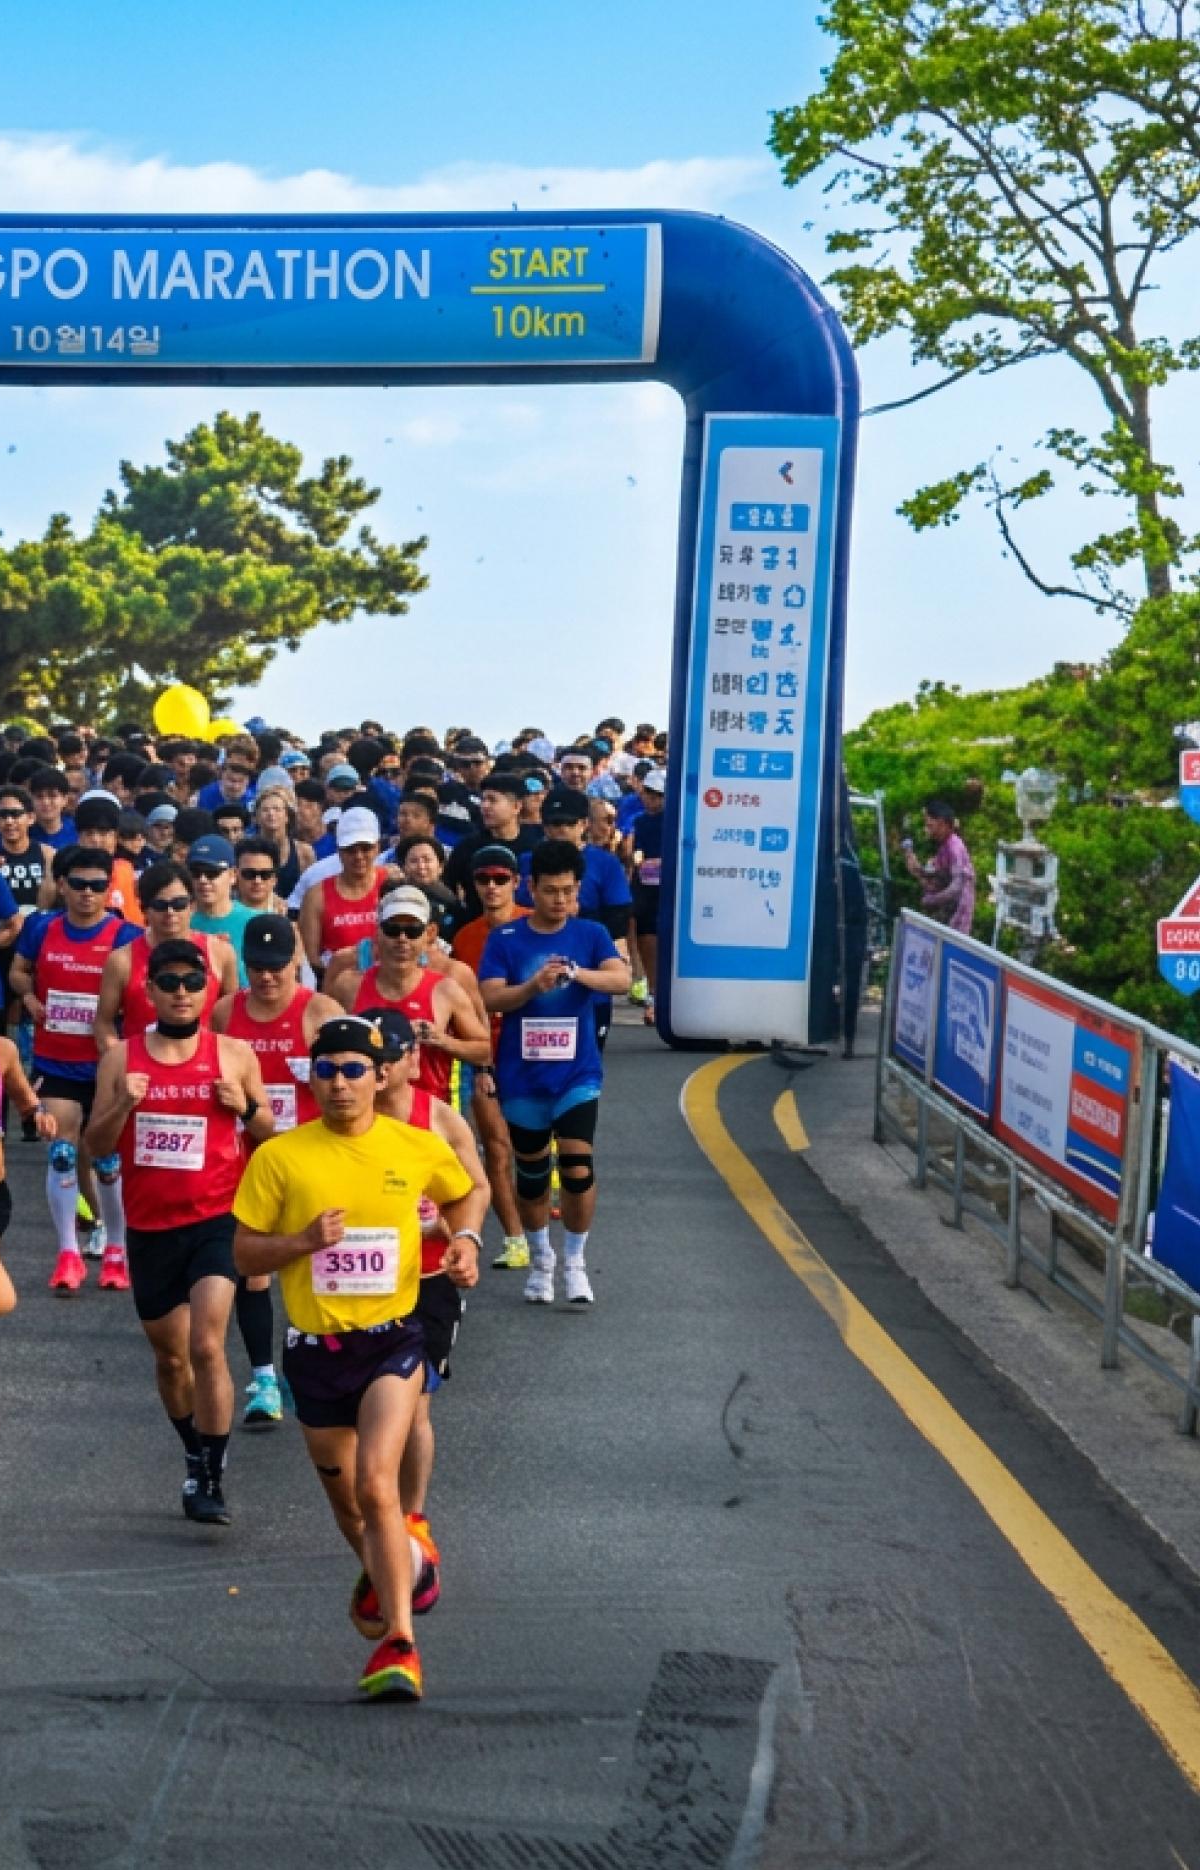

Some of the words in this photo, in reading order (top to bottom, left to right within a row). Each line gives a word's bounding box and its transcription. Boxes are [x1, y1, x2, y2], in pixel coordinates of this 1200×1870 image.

[111, 248, 432, 301] MARATHON
[488, 246, 589, 279] START
[492, 304, 586, 338] 10km
